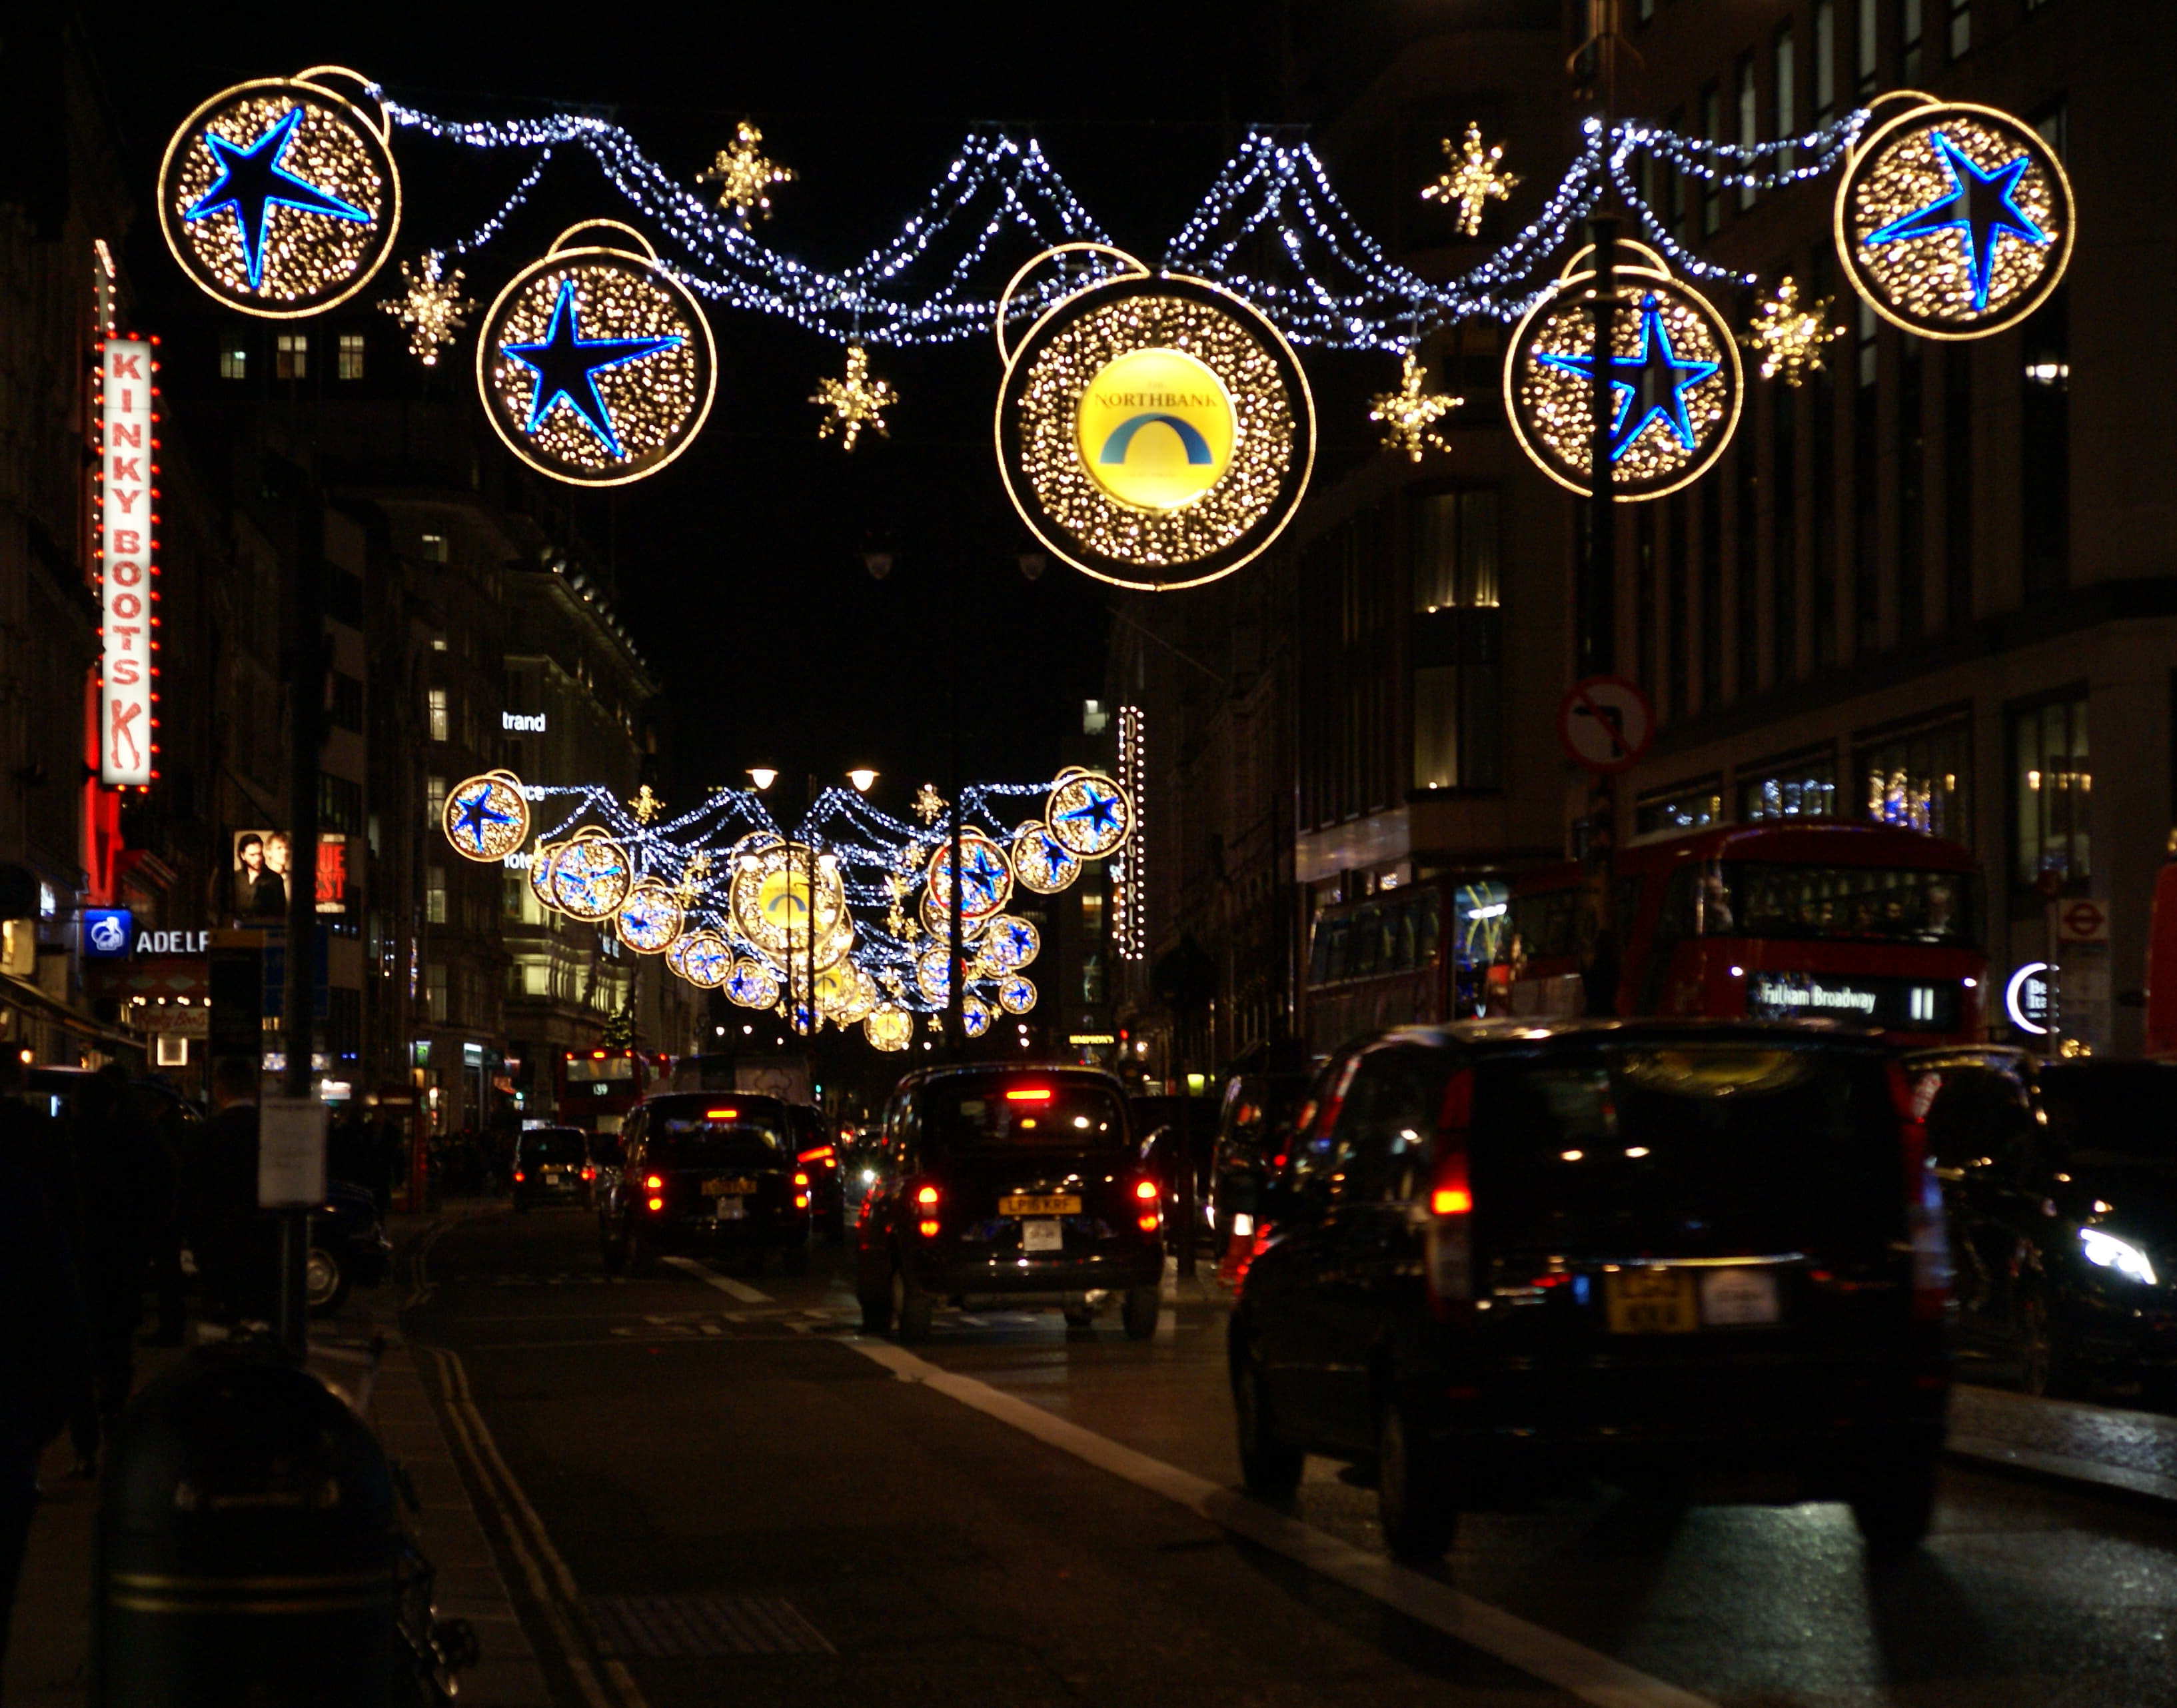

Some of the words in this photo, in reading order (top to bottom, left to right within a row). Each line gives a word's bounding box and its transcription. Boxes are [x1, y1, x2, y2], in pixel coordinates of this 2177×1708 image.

[112, 353, 142, 514] KINKY
[1095, 393, 1217, 409] NORTHBANK
[112, 529, 142, 685] BOOTS
[1763, 983, 1810, 1006] Fulham
[1811, 985, 1876, 1014] Broadway
